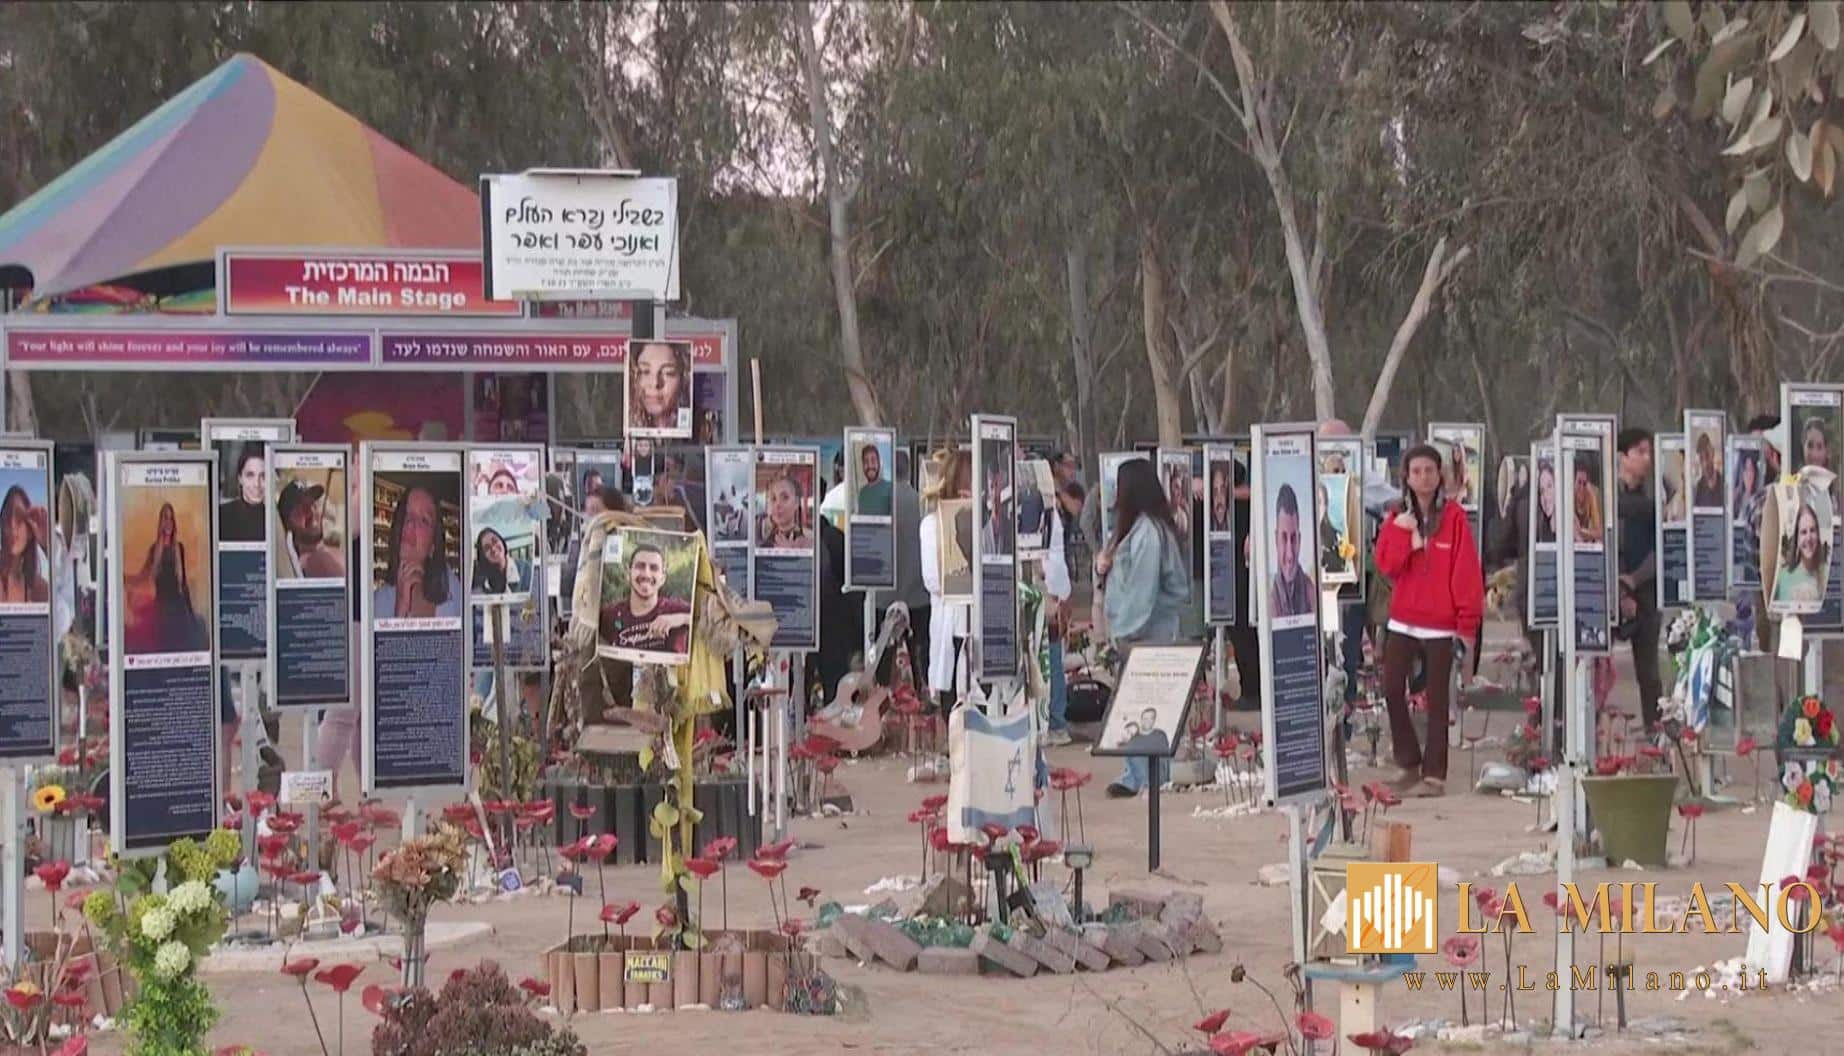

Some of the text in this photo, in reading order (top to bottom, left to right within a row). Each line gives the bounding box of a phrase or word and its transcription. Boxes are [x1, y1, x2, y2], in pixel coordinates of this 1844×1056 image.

[505, 195, 664, 230] בשבילי נברא העולם
[510, 231, 659, 256] ואנוכי עפר ואפר
[303, 260, 449, 283] הבמה המרכזית
[286, 286, 466, 309] The Main Stage
[50, 340, 74, 355] light
[76, 340, 95, 353] will
[97, 340, 125, 353] shine
[127, 340, 163, 353] forever
[166, 340, 184, 353] and
[187, 342, 208, 355] your
[211, 340, 225, 355] joy
[228, 340, 247, 353] will
[249, 340, 261, 353] be
[263, 340, 324, 353] remembered
[392, 338, 422, 357] לעד.
[427, 343, 467, 357] שנדמו
[472, 343, 530, 358] והשמחה
[534, 343, 568, 357] האור
[573, 343, 591, 357] עם
